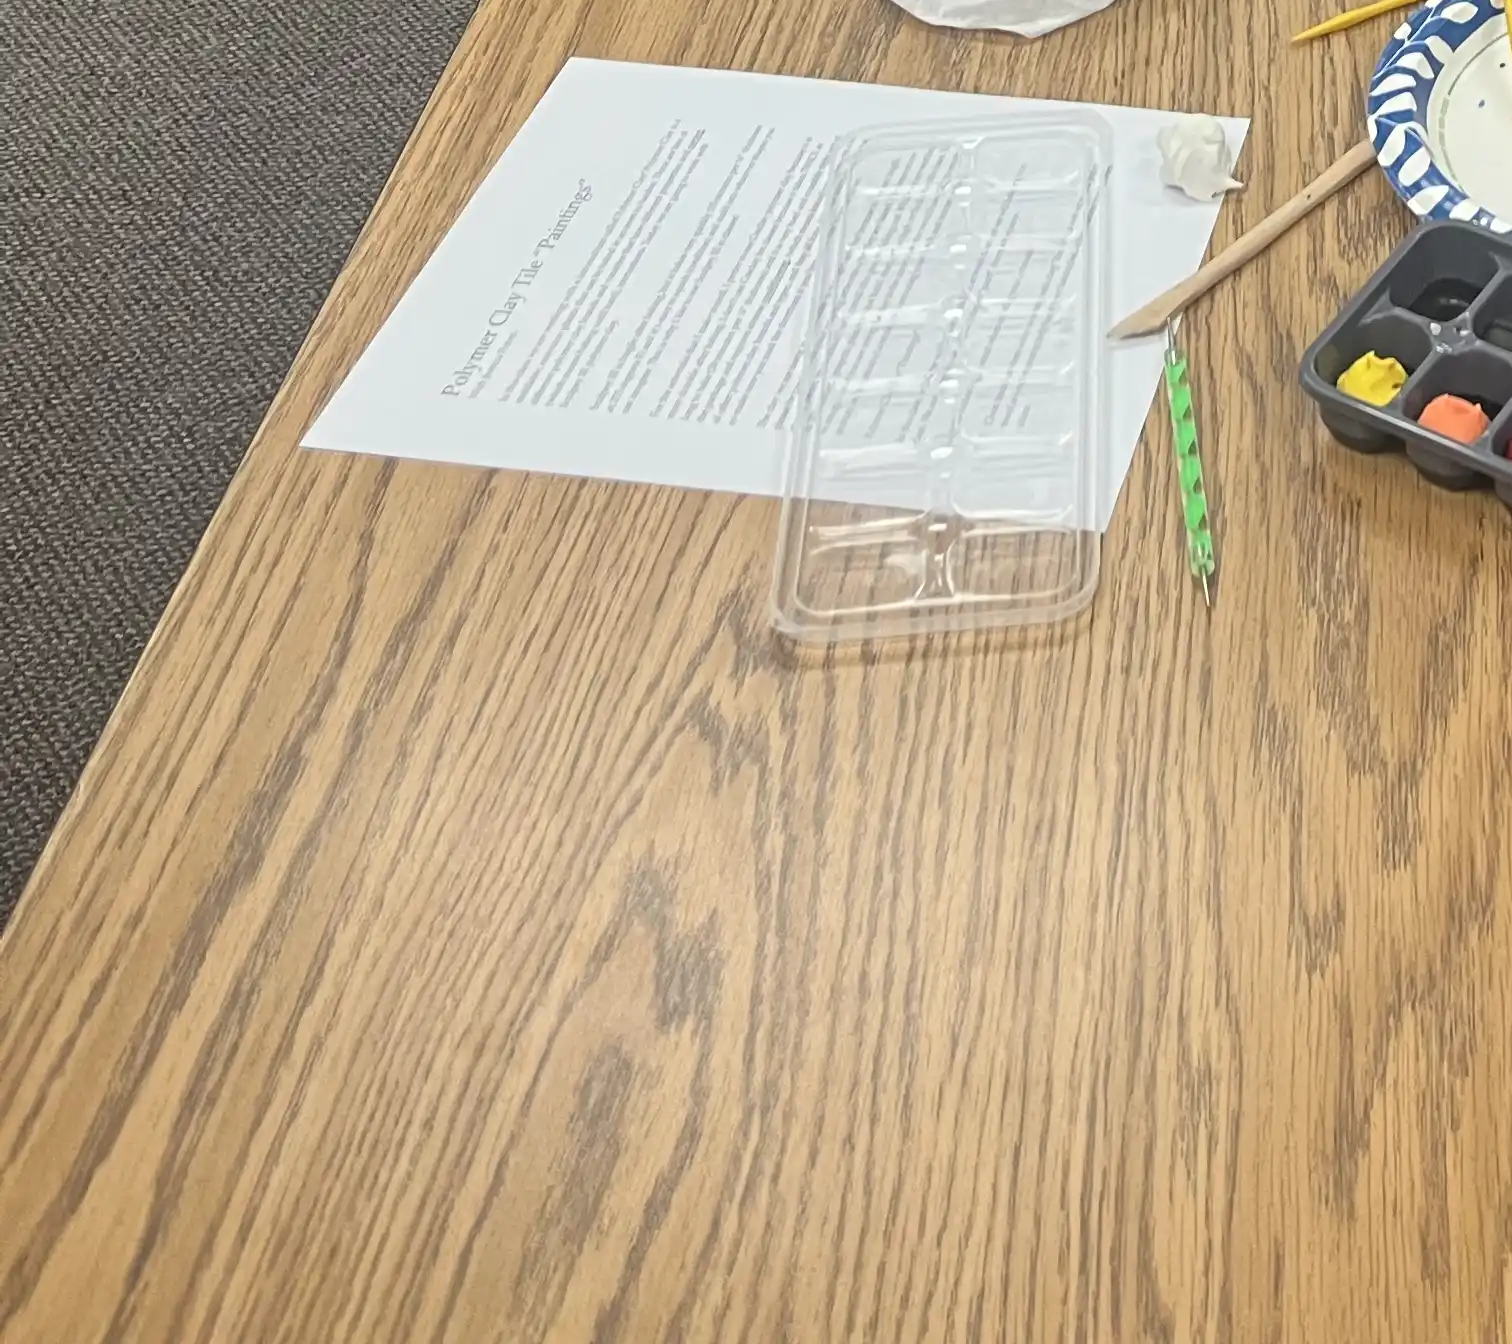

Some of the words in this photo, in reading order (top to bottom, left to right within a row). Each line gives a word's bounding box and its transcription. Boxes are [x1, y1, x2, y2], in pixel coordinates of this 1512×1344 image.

[440, 329, 498, 397] Polymer
[488, 291, 527, 326] Clay
[511, 259, 543, 287] Tile
